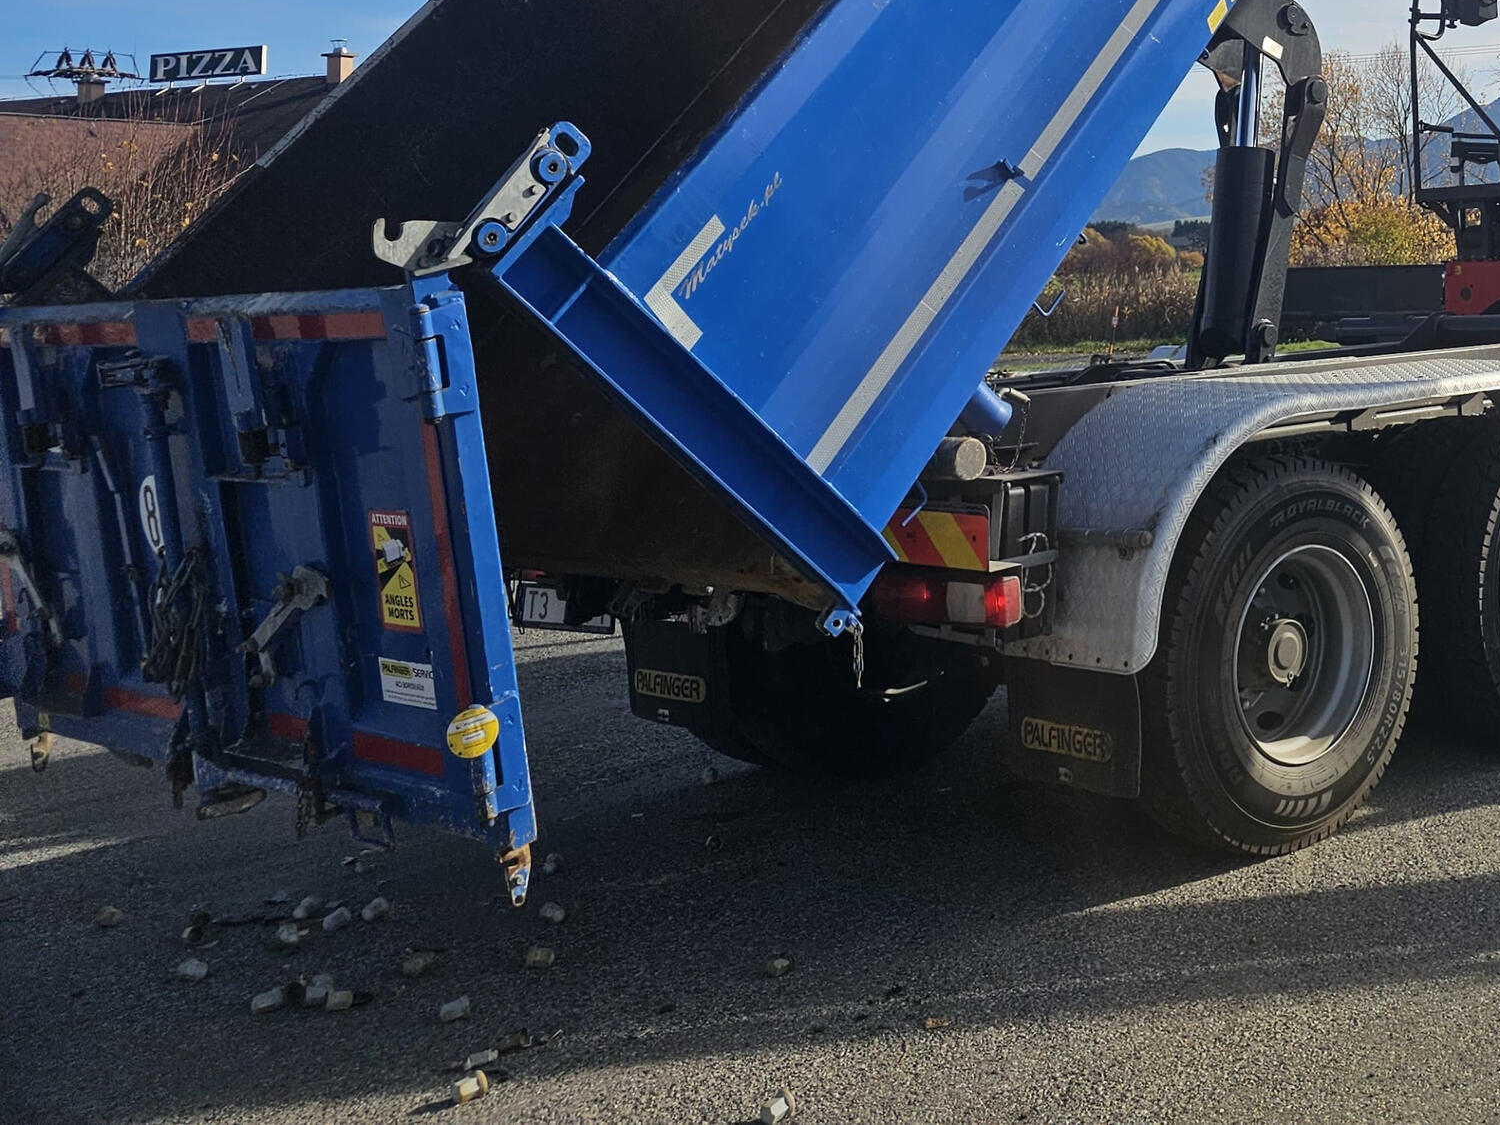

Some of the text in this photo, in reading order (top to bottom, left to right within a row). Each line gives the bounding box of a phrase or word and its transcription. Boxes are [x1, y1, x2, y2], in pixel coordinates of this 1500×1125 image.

[153, 49, 258, 81] PIZZA
[371, 513, 408, 526] ATTENTION
[1269, 498, 1371, 530] ROYALBLACK
[384, 594, 414, 608] ANGLES
[387, 606, 415, 621] MORTS
[636, 670, 701, 700] PALFINGER
[1366, 644, 1408, 766] 315/80R22.5
[1023, 720, 1106, 759] PALFINGER
